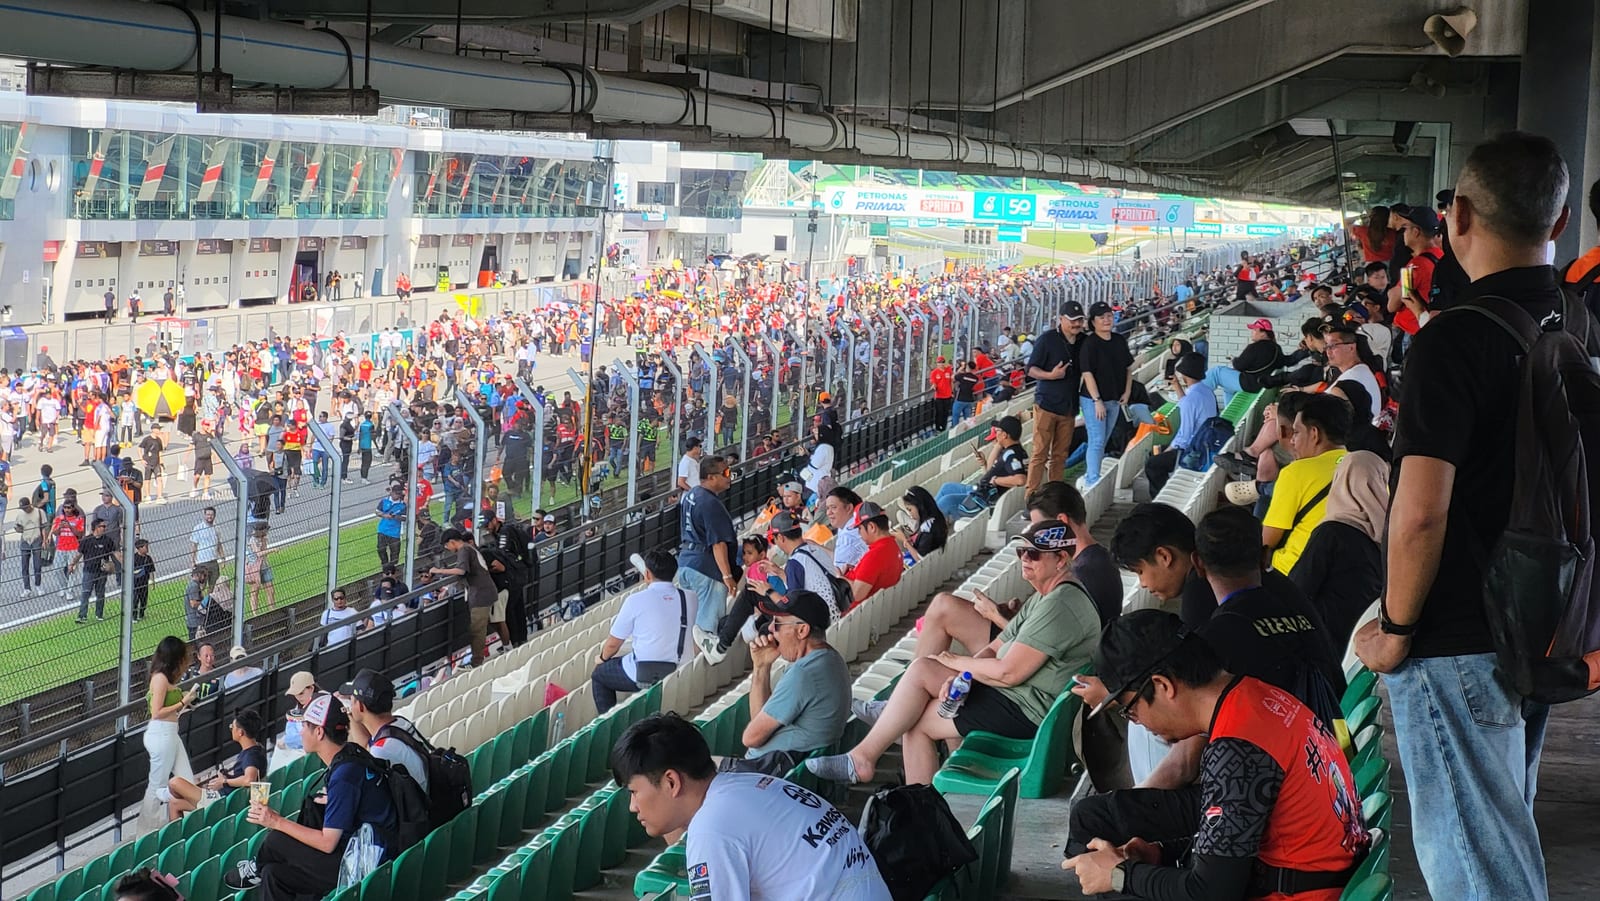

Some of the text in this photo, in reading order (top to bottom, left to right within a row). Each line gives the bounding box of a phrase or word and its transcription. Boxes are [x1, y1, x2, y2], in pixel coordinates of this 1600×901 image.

[857, 192, 908, 201] PETRONAS
[855, 201, 907, 212] PRIMAX
[921, 200, 963, 213] SPRINTA
[1009, 198, 1031, 215] 50
[1049, 200, 1100, 209] PETRONAS
[1047, 209, 1099, 220] PRIMAX
